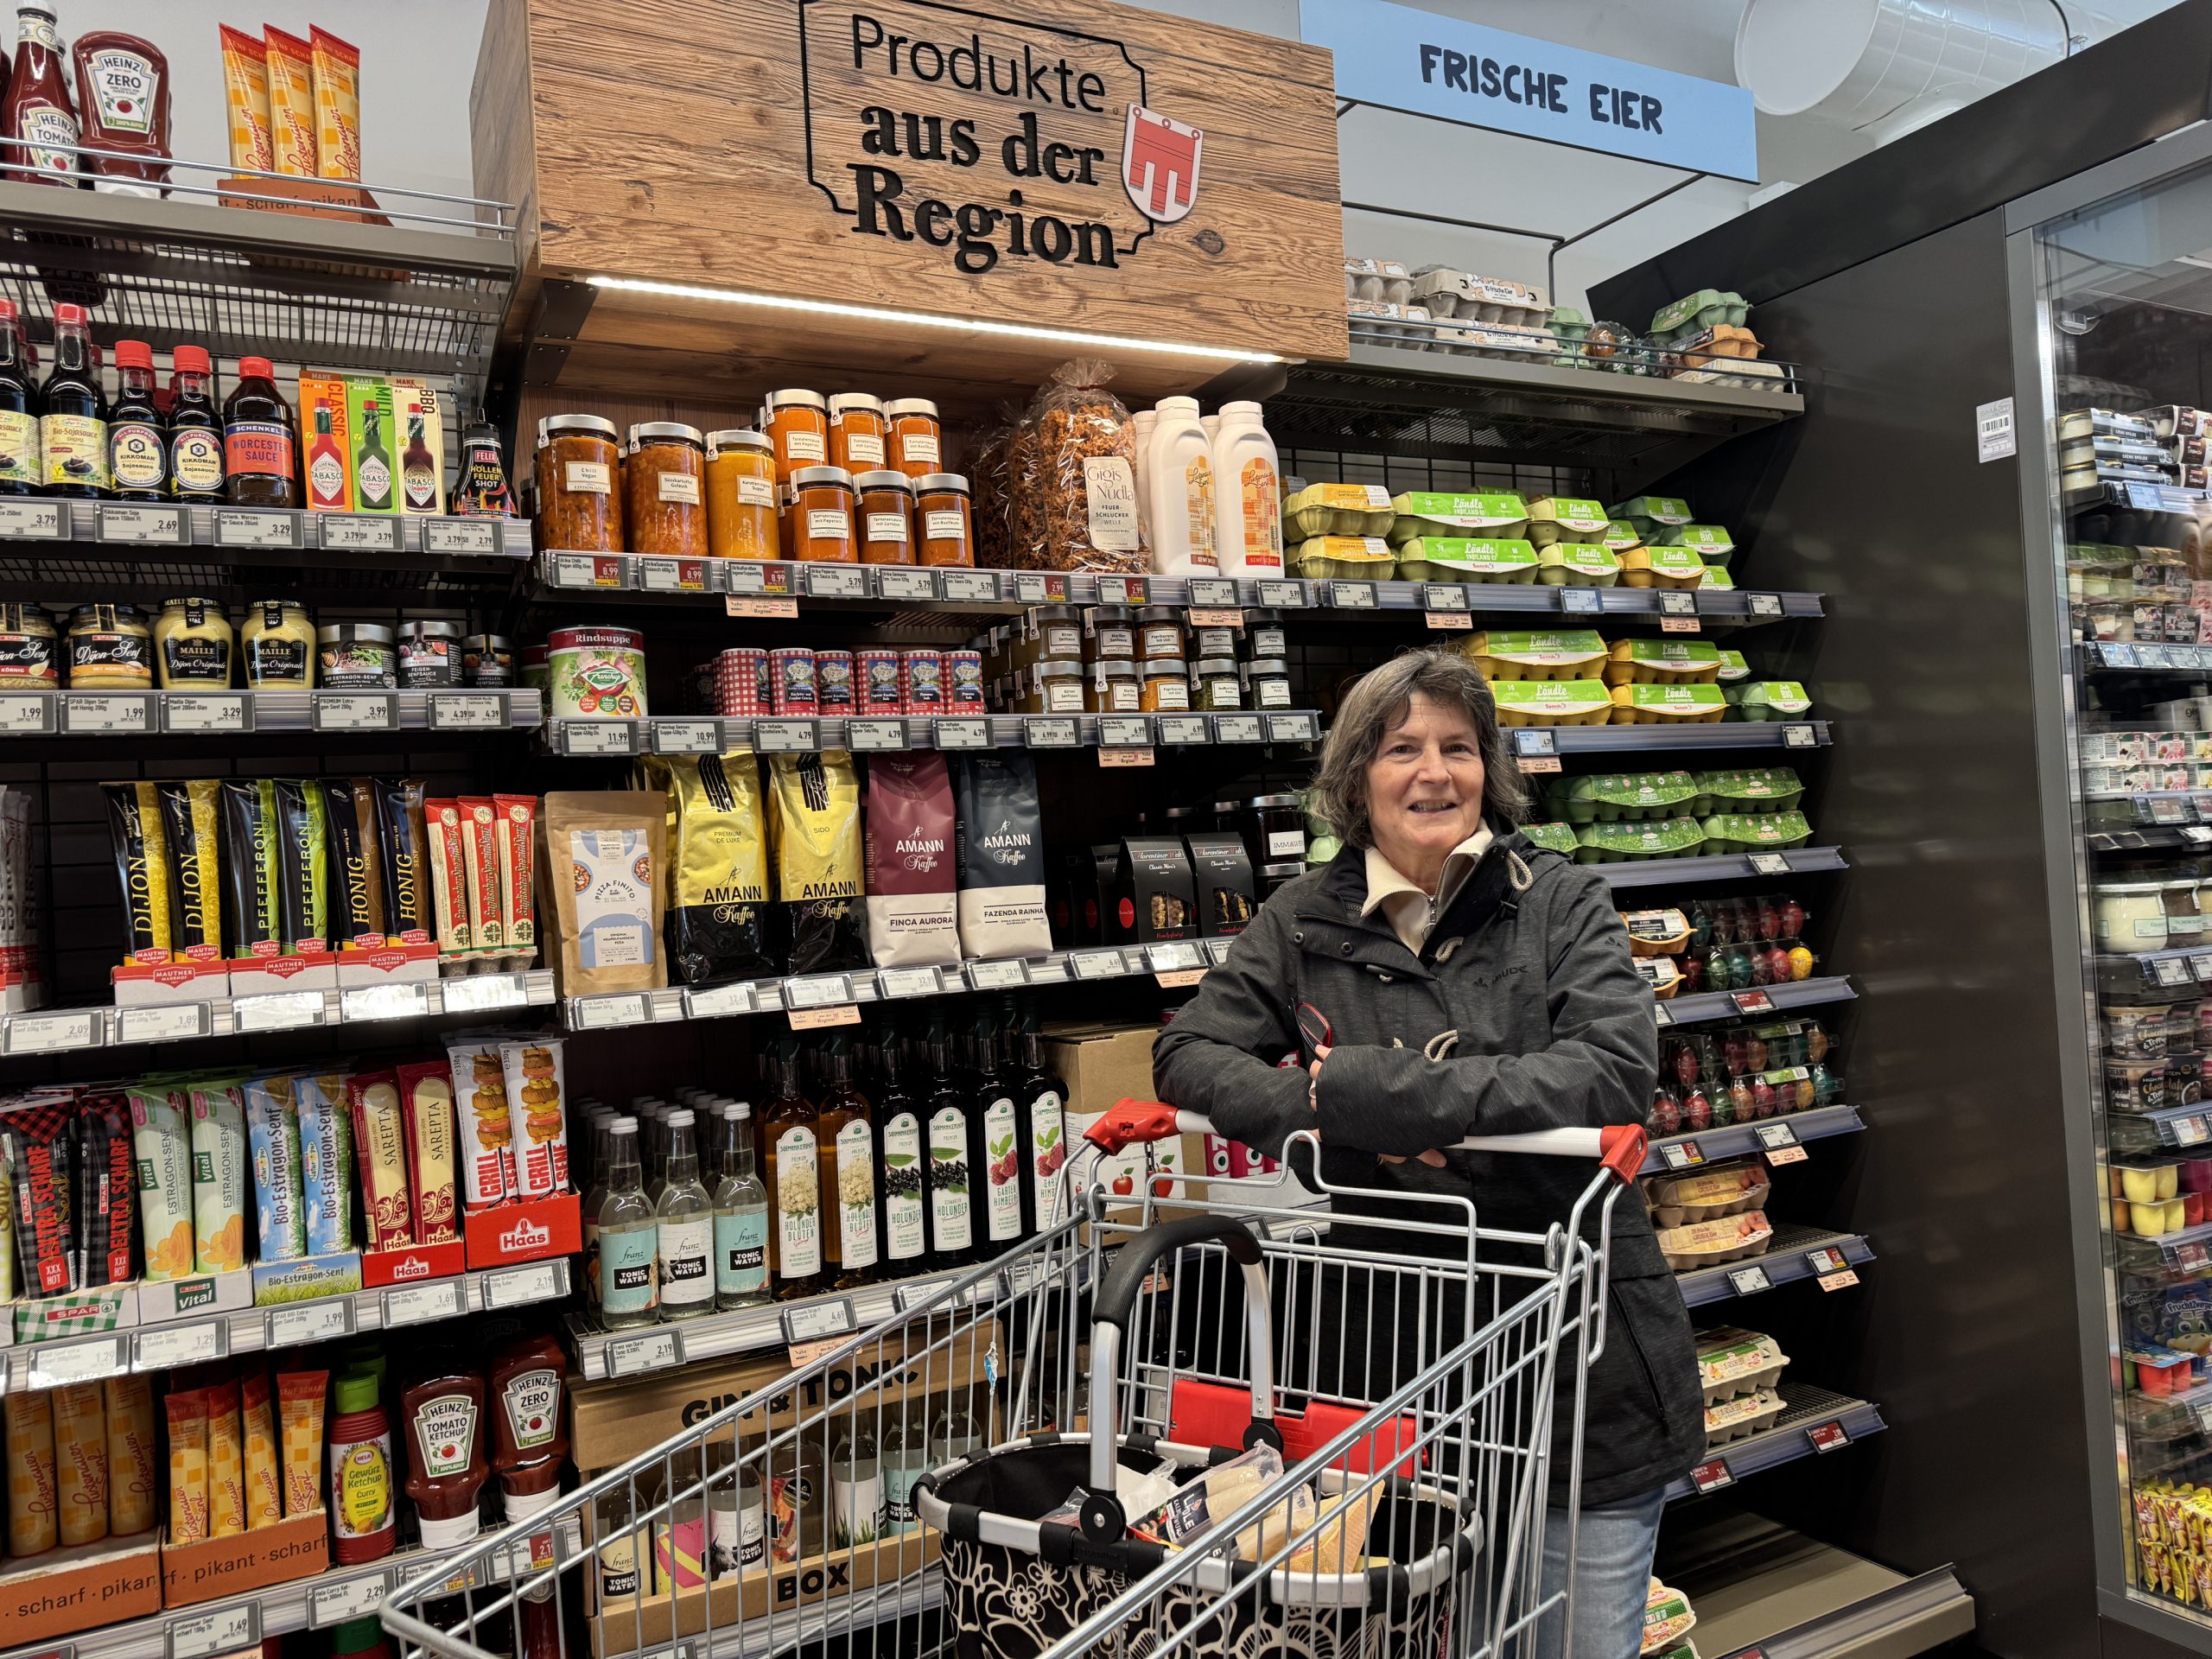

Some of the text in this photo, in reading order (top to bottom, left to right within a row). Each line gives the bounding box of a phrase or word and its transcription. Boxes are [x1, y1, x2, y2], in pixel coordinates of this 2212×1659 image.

[104, 57, 141, 73] HEINZ
[852, 13, 1105, 113] Produkte
[107, 73, 142, 89] ZERO
[1420, 43, 1663, 135] FRISCHE EIER
[36, 129, 77, 148] TOMATO
[860, 105, 1105, 187] aus der
[846, 162, 1120, 274] Region
[376, 386, 392, 416] MILD
[419, 389, 435, 415] BBQ
[327, 383, 346, 437] CLASSIC
[53, 428, 98, 438] Bio-Sojasauce
[236, 424, 281, 435] SCHENKEL
[232, 438, 289, 454] WORCESTER
[245, 450, 278, 462] SAUCE
[476, 451, 496, 462] FELIX
[311, 471, 343, 480] TABASCO
[471, 464, 501, 474] HÖLLEN
[359, 474, 391, 483] TABASCO
[474, 473, 499, 481] FEUER
[474, 480, 498, 488] SHOT
[1087, 466, 1122, 488] Gigis
[1097, 485, 1134, 501] Nudla
[1452, 497, 1484, 510] Ländle
[36, 514, 56, 524] 3.79
[158, 520, 177, 530] 2.69
[272, 524, 290, 534] 3.29
[345, 531, 359, 540] 3.79
[479, 537, 492, 545] 2.79
[1700, 533, 1713, 542] BIO
[1465, 543, 1496, 554] Ländle
[602, 567, 618, 576] 8.99
[918, 580, 931, 588] 5.79
[1052, 584, 1064, 593] 2.99
[1132, 586, 1143, 594] 2.99
[575, 634, 631, 645] Rindsuppe
[76, 641, 142, 664] Dijon-Senf
[170, 658, 226, 670] Dijon Originale
[21, 708, 41, 718] 1.99
[124, 708, 144, 718] 1.99
[222, 708, 241, 718] 3.29
[369, 707, 387, 716] 3.99
[608, 733, 628, 741] 11.99
[696, 732, 715, 741] 10.99
[798, 731, 811, 740] 4.79
[888, 730, 900, 739] 4.79
[895, 839, 944, 853] AMANN
[904, 855, 938, 873] Kaffee
[255, 821, 270, 930] PFEFFERONI
[299, 820, 314, 928] PFEFFERONI
[130, 856, 152, 932] DIJON
[181, 853, 204, 930] DIJON
[346, 857, 370, 925] HONIG
[396, 853, 416, 921] HONIG
[594, 880, 635, 901] PIZZA FINITO
[803, 880, 857, 899] AMANN
[703, 885, 762, 904] AMANN
[714, 904, 755, 925] Kaffee
[811, 899, 850, 919] Kaffee
[984, 907, 1044, 918] FAZENDA RAINHA
[890, 916, 954, 927] FINCA AURORA
[269, 961, 302, 970] MAUTNER
[156, 969, 193, 978] MAUTNER
[178, 1014, 198, 1025] 1.89
[69, 1025, 89, 1035] 2.09
[378, 1106, 398, 1166] SAREPTA
[428, 1101, 444, 1161] SAREPTA
[175, 1127, 187, 1187] ZUCKERZUSATZ
[321, 1103, 337, 1220] Bio-Estragon-Senf
[551, 1143, 569, 1184] SENF
[110, 1137, 130, 1195] SCHARF
[161, 1128, 178, 1216] ESTRAGON-SENF
[198, 1154, 213, 1180] Vital
[220, 1122, 232, 1209] ESTRAGON-SENF
[265, 1107, 289, 1225] Bio-Estragon-Senf
[526, 1145, 550, 1191] GRILL
[28, 1145, 55, 1204] SCHARF
[141, 1162, 156, 1188] Vital
[478, 1152, 502, 1198] GRILL
[997, 1185, 1017, 1197] GARTEN
[938, 1202, 968, 1216] HOLUNDER
[110, 1197, 130, 1249] EXTRA
[785, 1217, 816, 1230] HOLUNDER
[892, 1210, 921, 1224] HOLUNDER
[35, 1205, 61, 1258] EXTRA
[788, 1228, 814, 1242] BLÜTEN
[386, 1236, 410, 1251] Haas
[502, 1230, 547, 1249] Haas
[114, 1255, 127, 1266] XXX
[619, 1246, 644, 1264] franz
[734, 1255, 762, 1266] WATER
[737, 1252, 760, 1261] TONIC
[46, 1264, 61, 1275] XXX
[114, 1265, 126, 1276] HOT
[394, 1264, 429, 1277] Haas
[675, 1266, 703, 1275] WATER
[677, 1261, 701, 1270] TONIC
[47, 1274, 60, 1285] HOT
[268, 1267, 346, 1287] Bio-Estragon-Senf
[536, 1275, 553, 1287] 2.19
[619, 1274, 647, 1285] WATER
[620, 1269, 645, 1280] TONIC
[179, 1290, 213, 1309] Vital
[56, 1305, 99, 1319] SPAR
[195, 1333, 215, 1346] 1.29
[658, 1344, 672, 1355] 2.19
[518, 1376, 547, 1392] HEINZ
[682, 1389, 753, 1428] GIN
[800, 1355, 918, 1406] TONIC
[520, 1391, 549, 1408] ZERO
[429, 1403, 462, 1419] HEINZ
[426, 1416, 467, 1433] TOMATO
[429, 1427, 467, 1442] KETCHUP
[356, 1453, 372, 1462] HELA
[349, 1466, 380, 1480] Gewürz
[347, 1473, 382, 1490] Ketchup
[356, 1489, 376, 1499] Curry
[194, 1534, 328, 1584] pikant scharf
[778, 1560, 849, 1603] BOX
[366, 1585, 385, 1599] 2.29
[18, 1586, 87, 1618] scharf
[229, 1618, 247, 1633] 1.49
